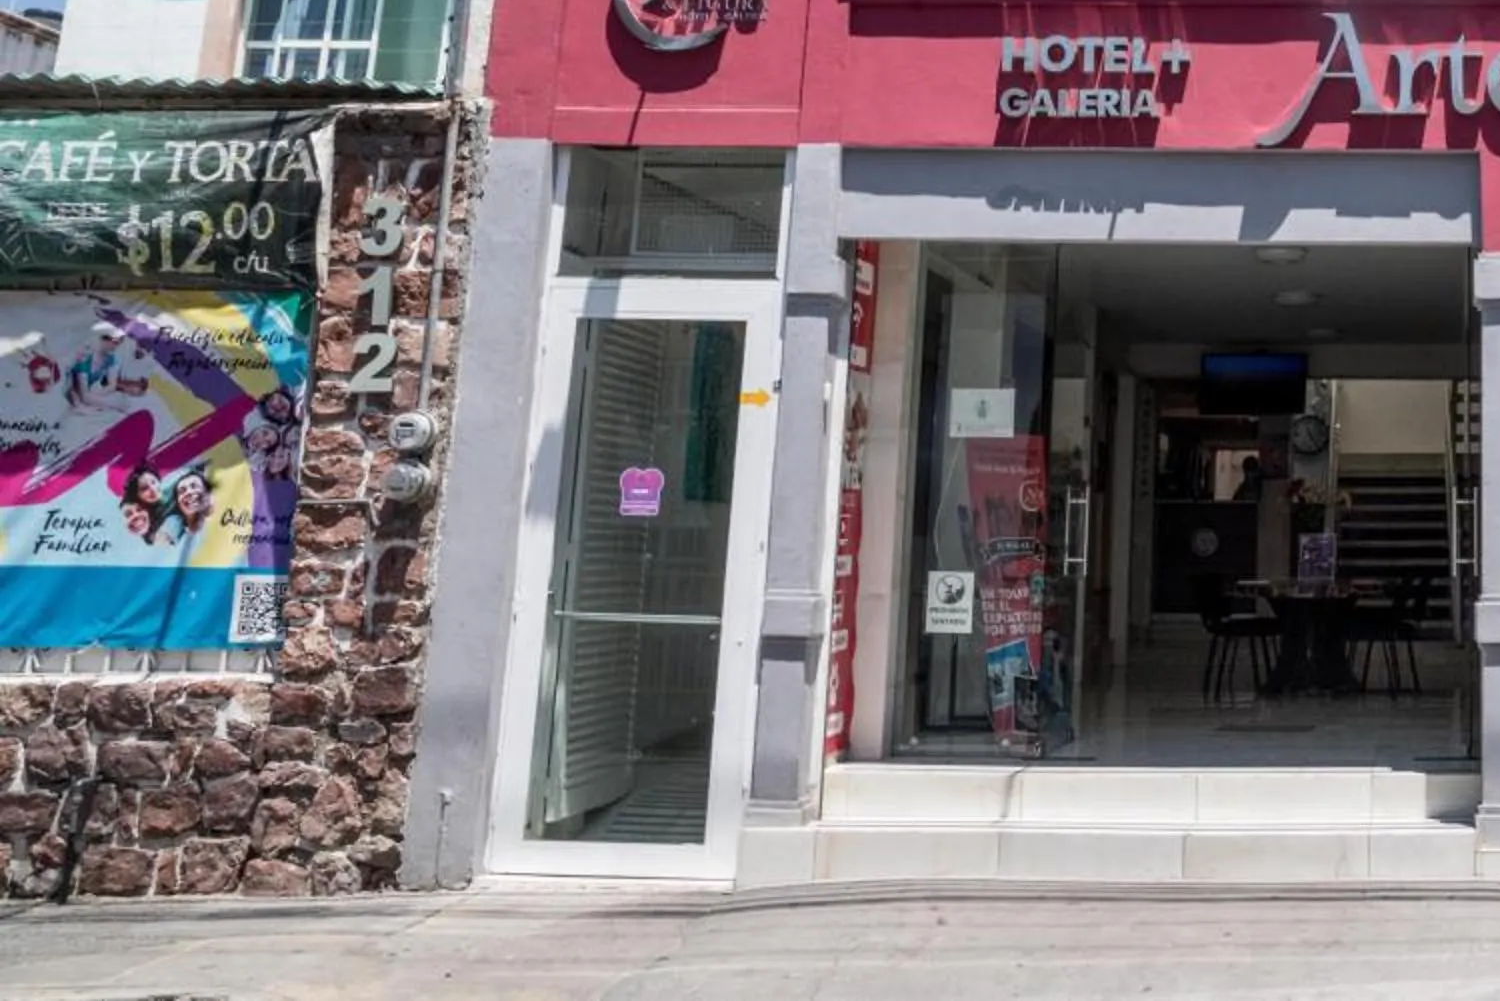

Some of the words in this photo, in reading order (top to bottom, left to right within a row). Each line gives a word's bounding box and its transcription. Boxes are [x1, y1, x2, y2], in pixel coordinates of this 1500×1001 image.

[1000, 35, 1157, 75] HOTEL
[999, 87, 1161, 119] GALERIA
[117, 201, 275, 277] $12.00
[349, 199, 404, 393] 312
[43, 509, 105, 536] Terapia
[33, 534, 111, 555] Familiar
